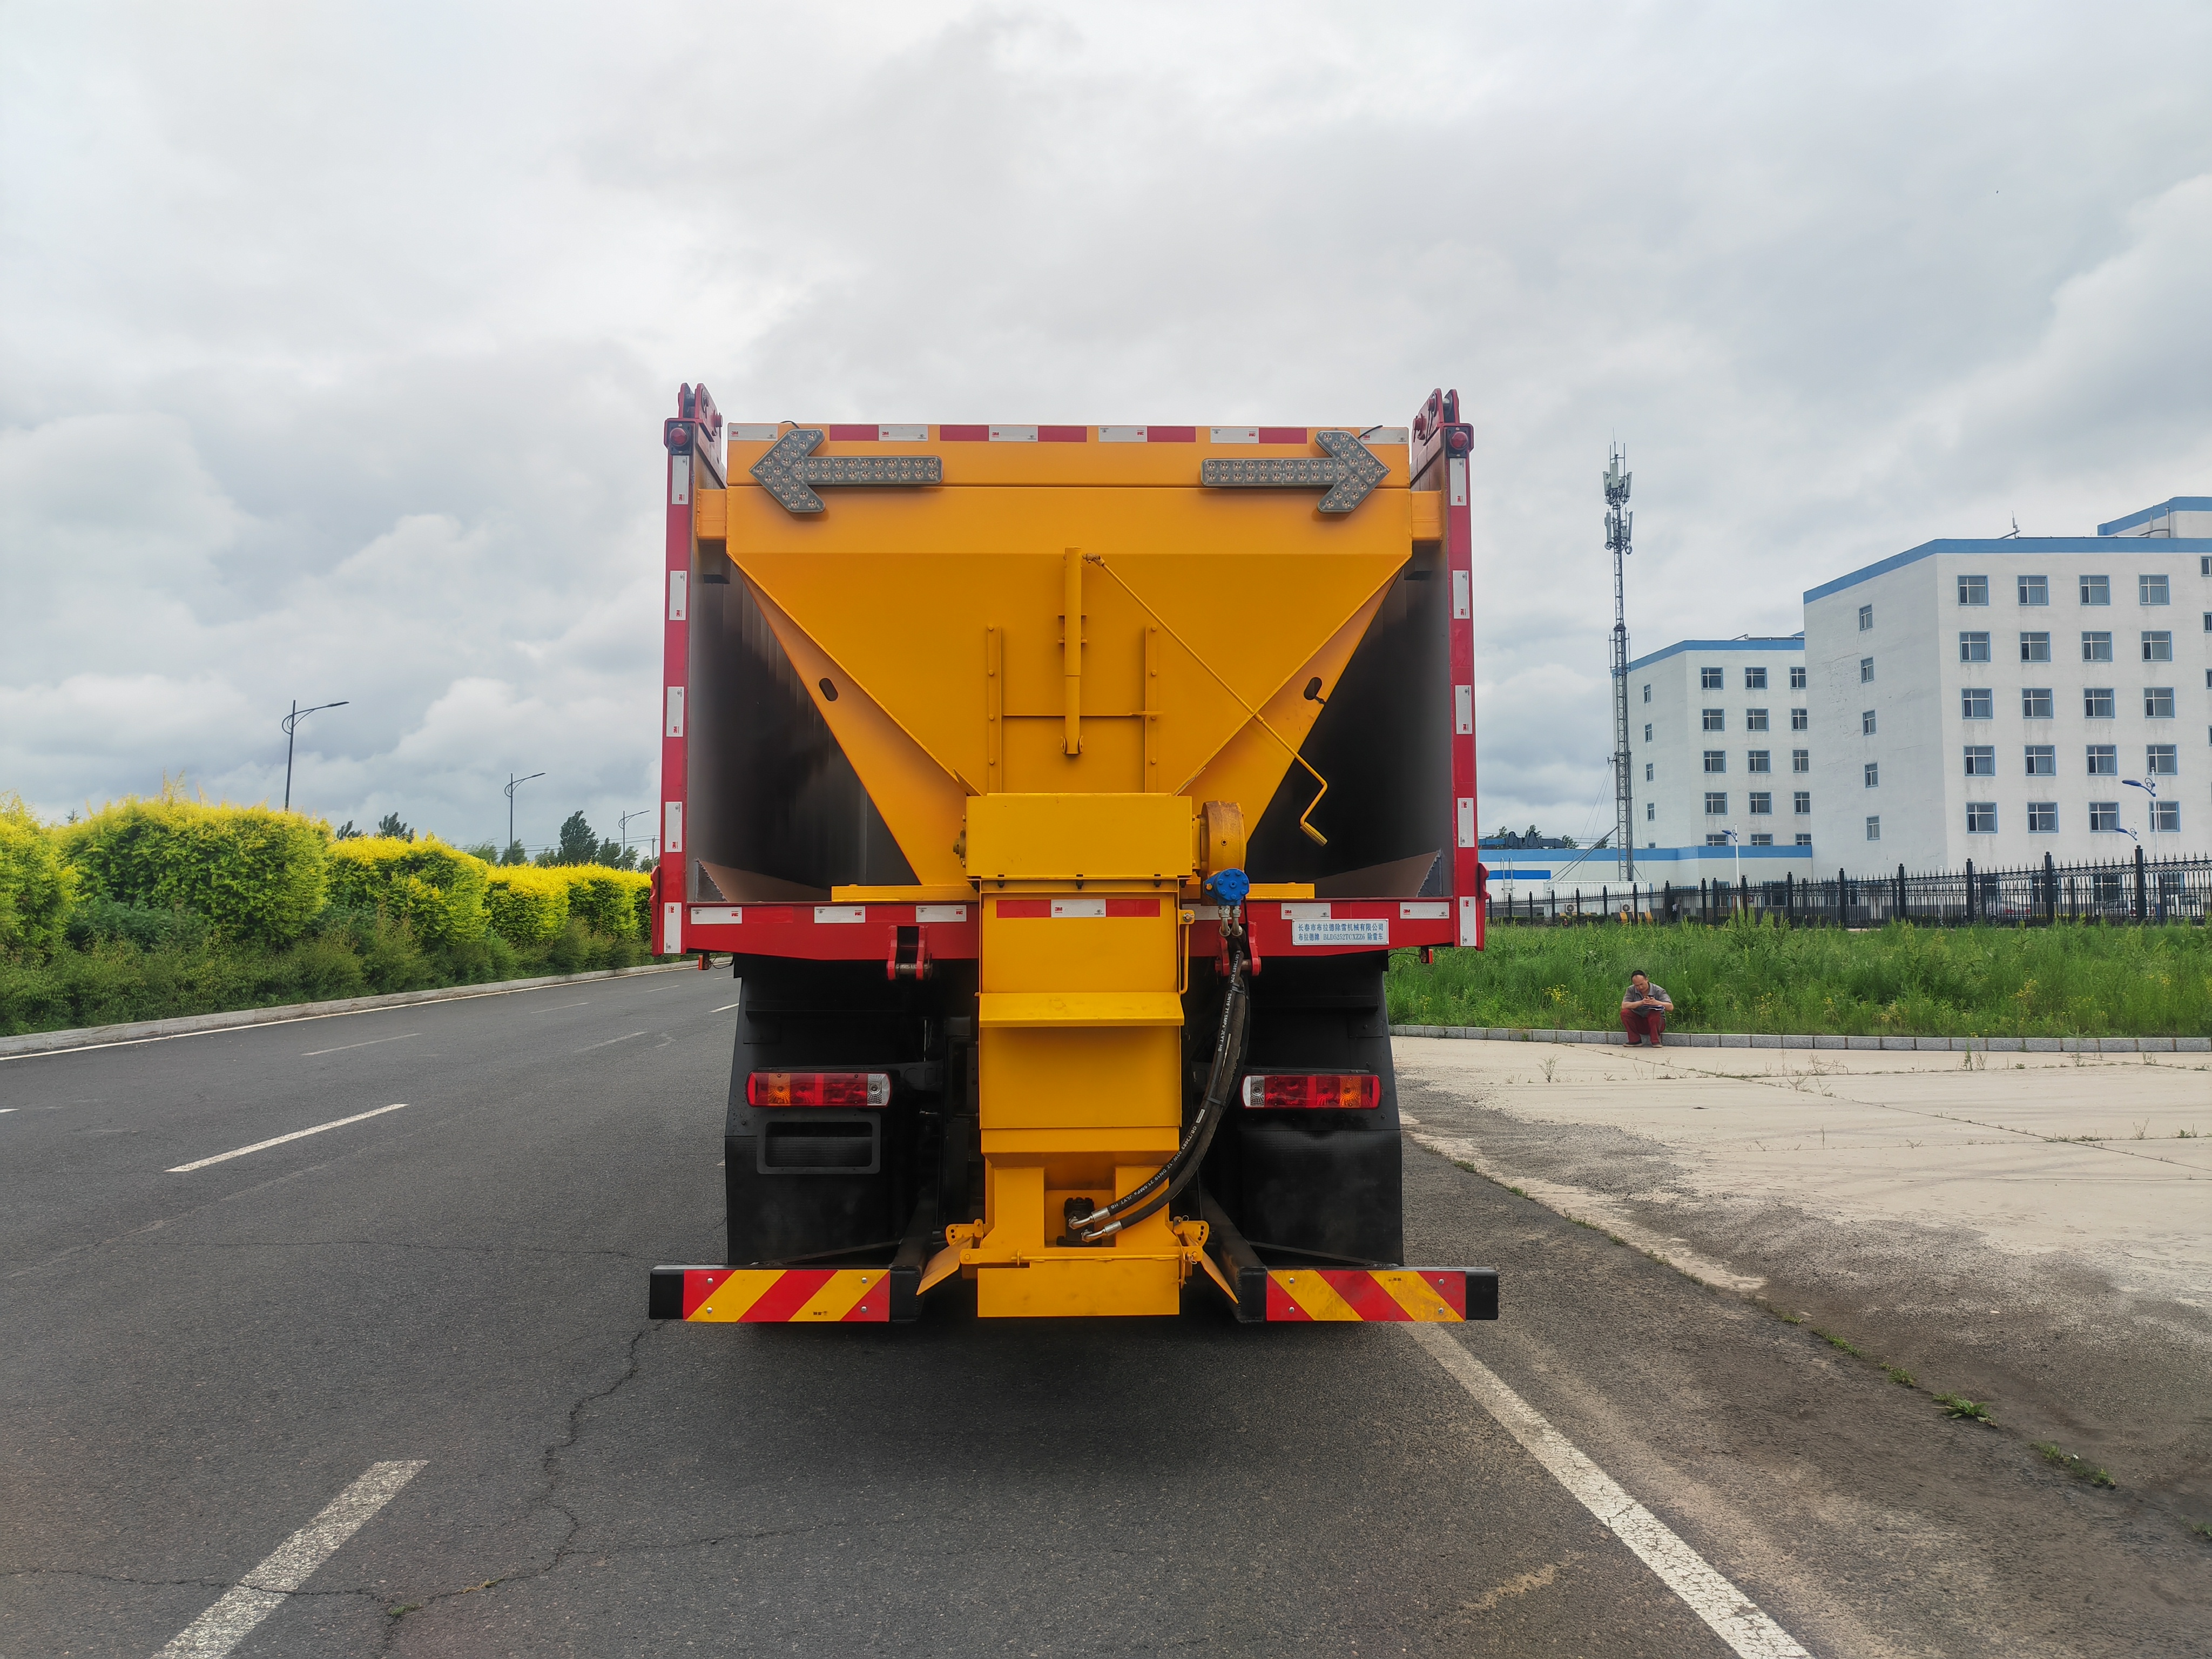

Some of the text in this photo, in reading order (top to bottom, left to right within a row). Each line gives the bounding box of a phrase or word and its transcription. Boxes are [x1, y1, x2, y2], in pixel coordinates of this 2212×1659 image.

[1298, 923, 1384, 932] 长春市布拉德除雪机械有限公司
[1298, 933, 1319, 941] 布拉德牌
[1367, 933, 1384, 941] 除雪车
[1217, 1044, 1223, 1052] HB
[1155, 1169, 1167, 1181] DN19
[1121, 1195, 1132, 1205] JLYT
